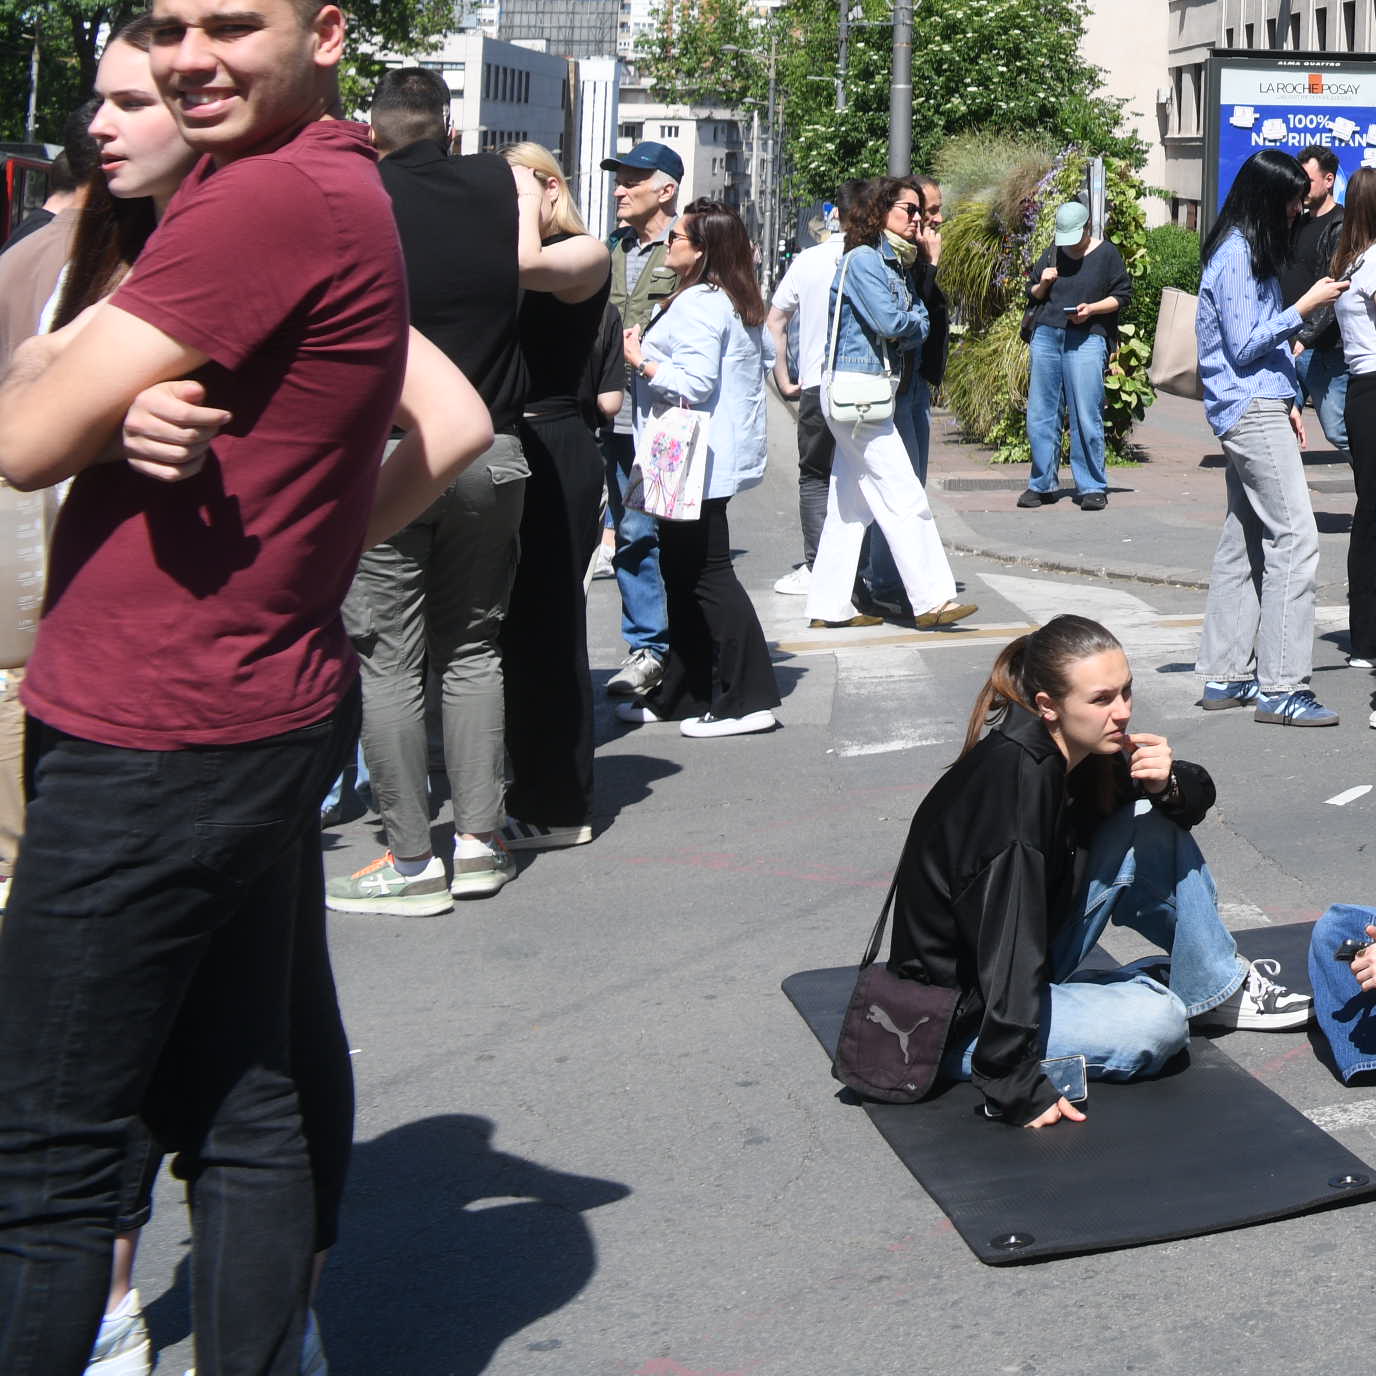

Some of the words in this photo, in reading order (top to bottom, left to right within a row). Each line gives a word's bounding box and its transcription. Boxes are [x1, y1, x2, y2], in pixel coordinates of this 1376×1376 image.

[1259, 82, 1275, 94] LA
[1277, 82, 1318, 94] ROCHE
[1287, 113, 1331, 129] 100%
